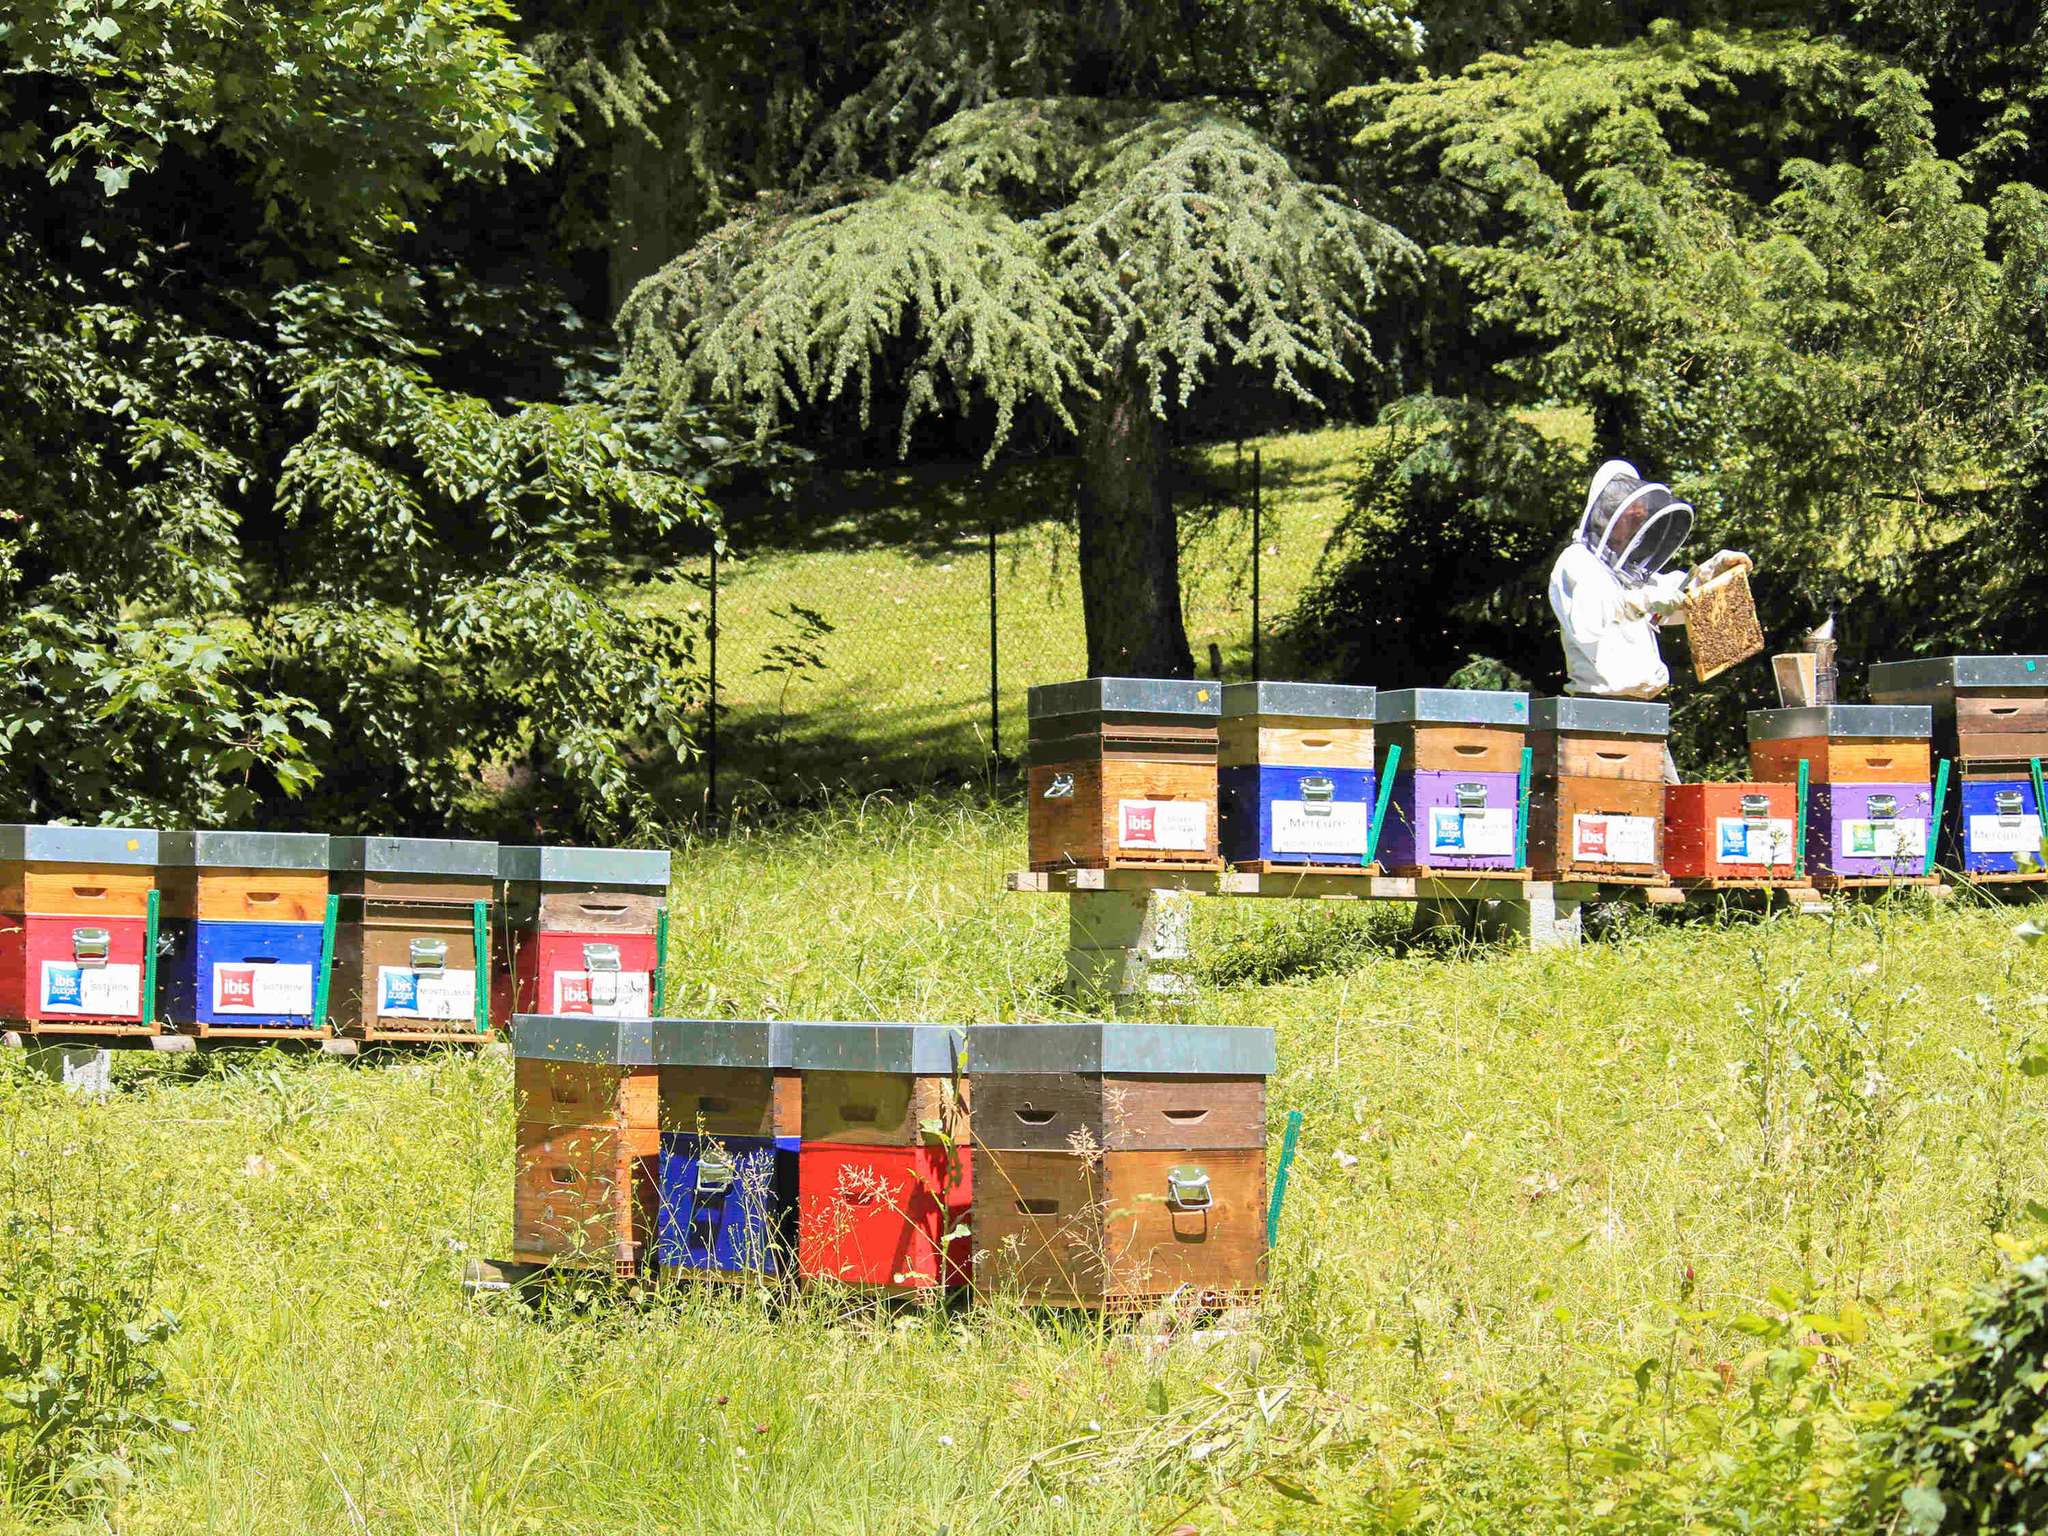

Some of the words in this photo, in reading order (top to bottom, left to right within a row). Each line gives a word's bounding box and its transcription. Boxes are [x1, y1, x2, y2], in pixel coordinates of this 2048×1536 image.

[1128, 815, 1152, 831] ibis
[1440, 822, 1459, 831] ibis
[1582, 829, 1604, 844] ibis
[55, 974, 75, 987] ibis
[224, 978, 250, 994] ibis
[392, 980, 412, 992] ibis
[51, 985, 78, 998] budget
[564, 986, 588, 1002] ibis
